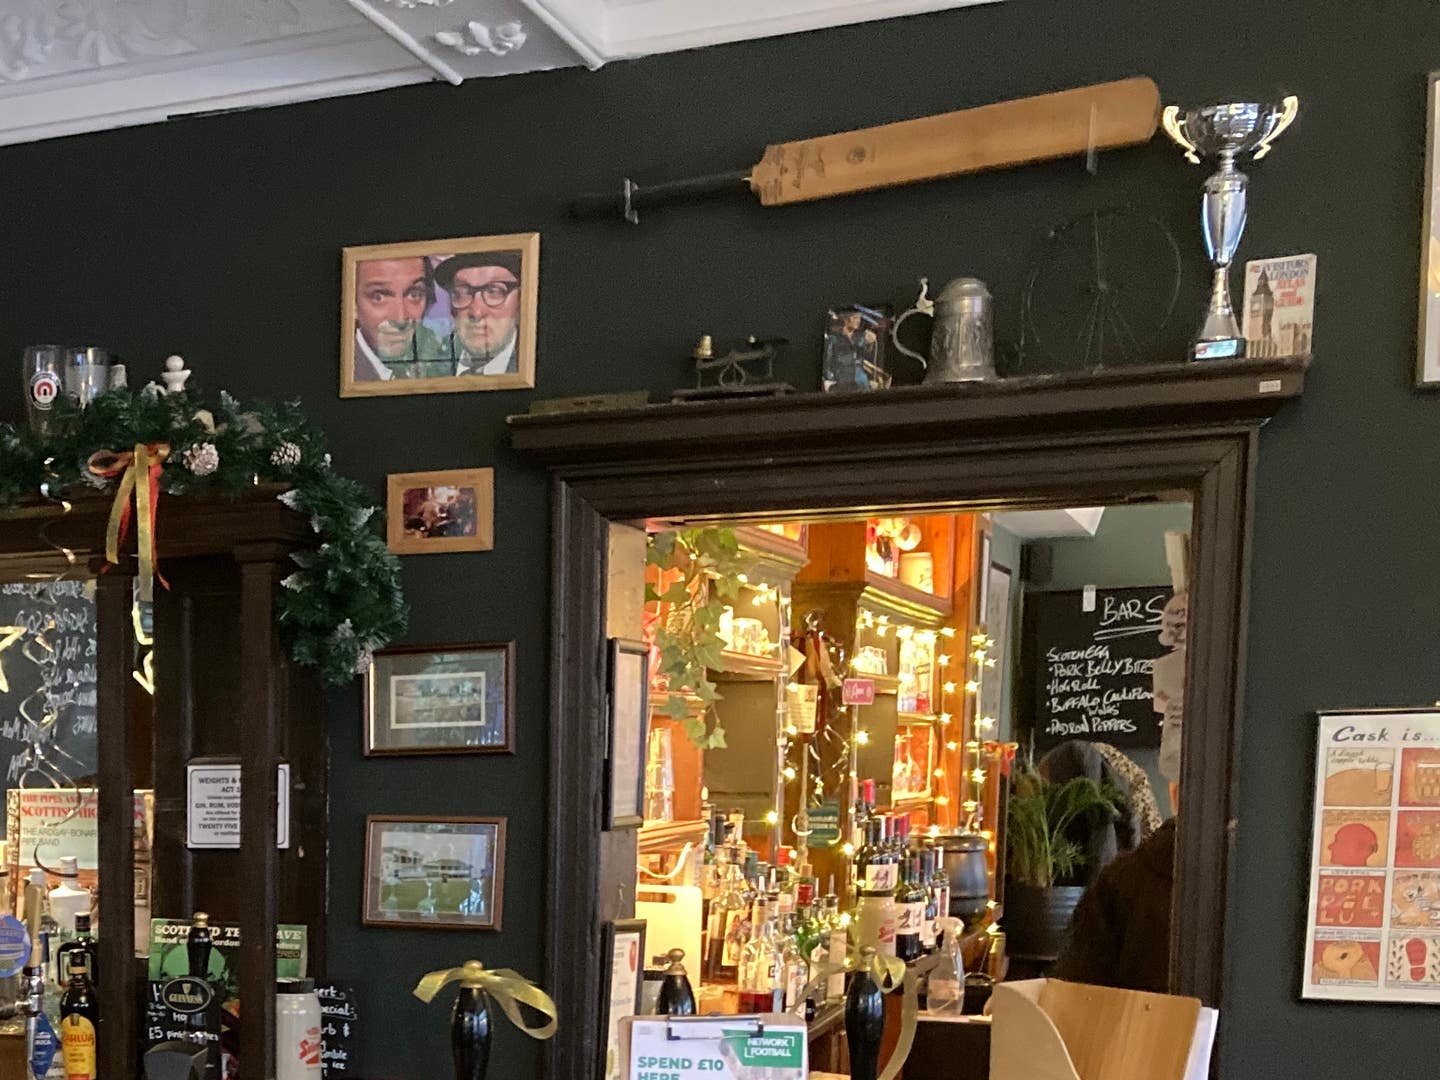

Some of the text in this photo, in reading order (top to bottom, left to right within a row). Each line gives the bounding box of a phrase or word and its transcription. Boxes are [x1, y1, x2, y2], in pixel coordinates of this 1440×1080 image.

[1054, 663, 1084, 677] PORK
[1071, 678, 1101, 692] ROLL
[1051, 693, 1101, 713] BUFFALO
[1331, 725, 1389, 743] Cask
[747, 1037, 789, 1047] NETWORK
[750, 1047, 792, 1057] FOOTBALL
[637, 1056, 724, 1071] SPEND £10
